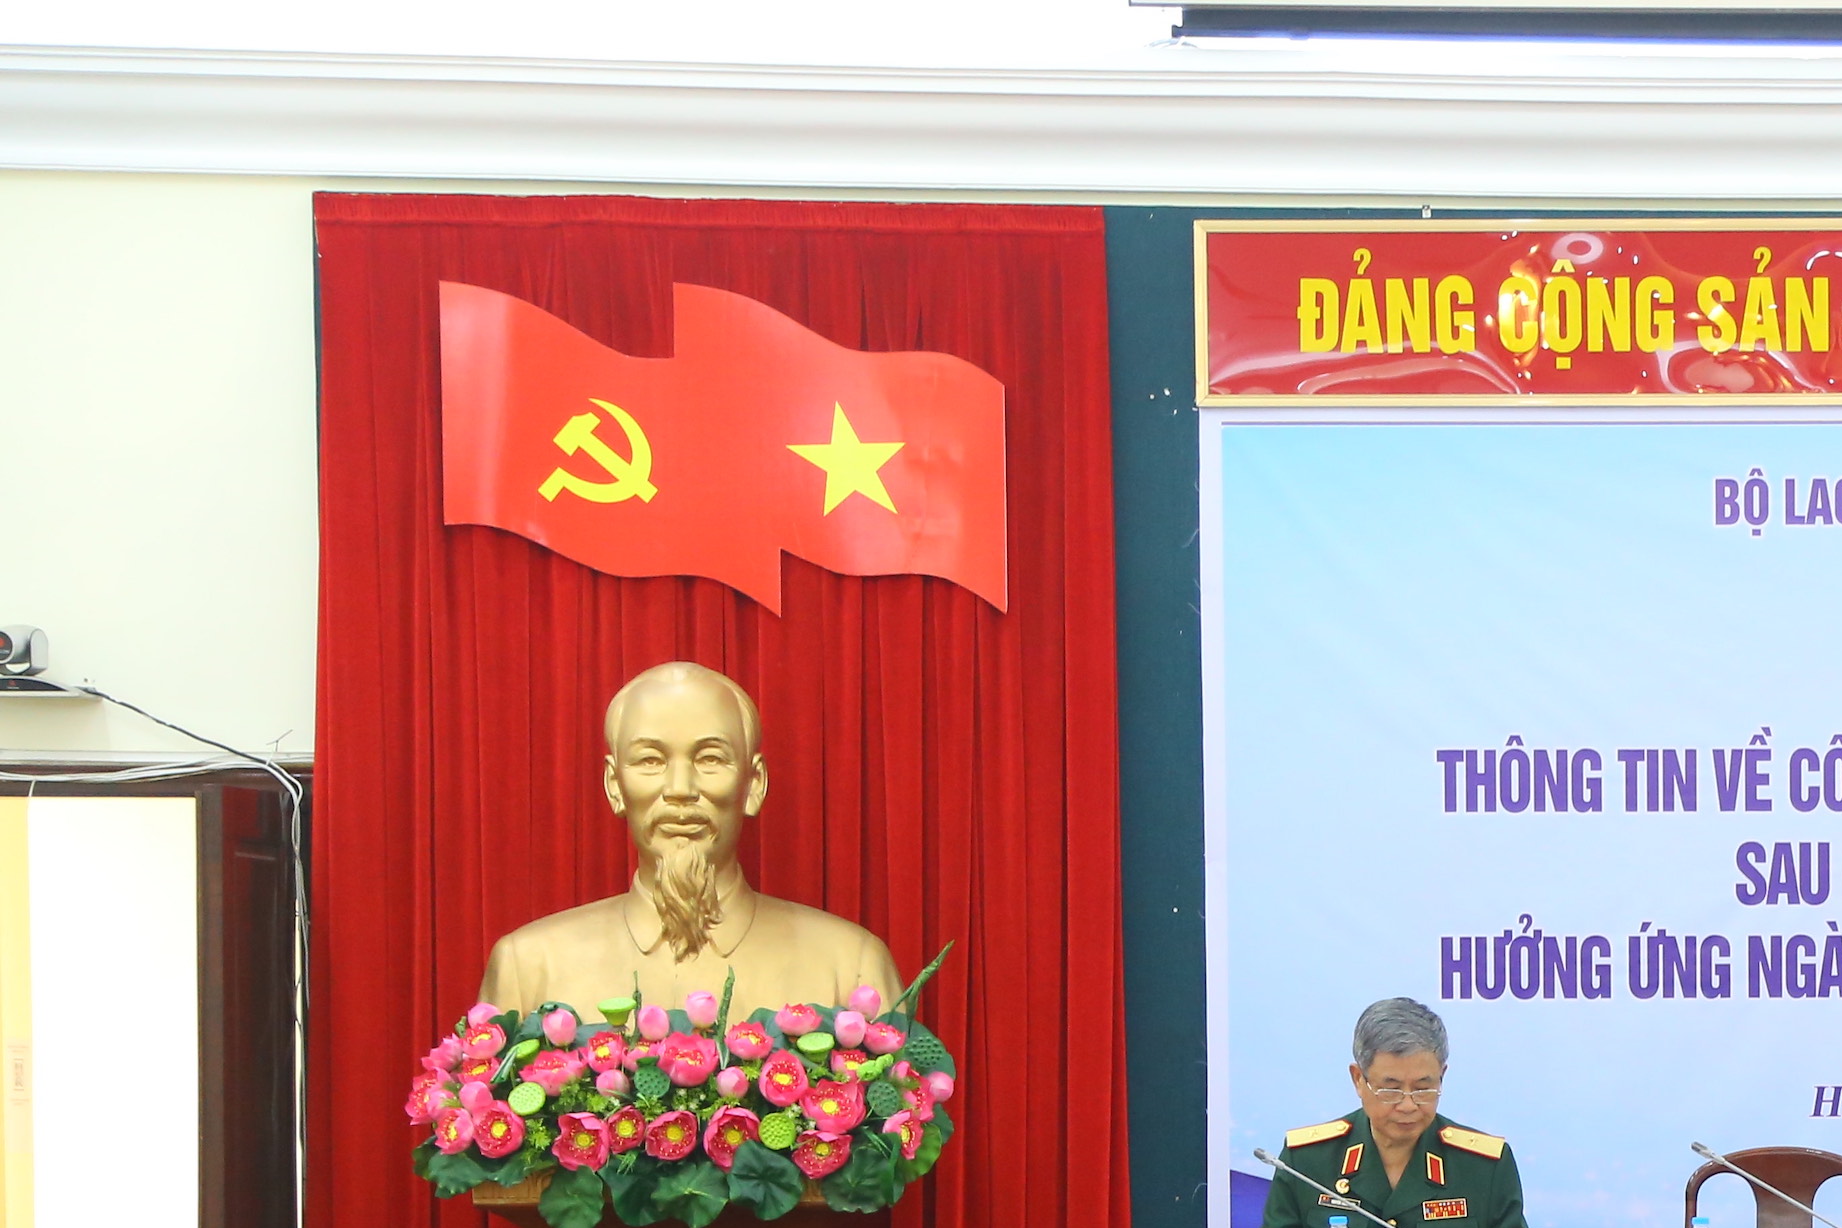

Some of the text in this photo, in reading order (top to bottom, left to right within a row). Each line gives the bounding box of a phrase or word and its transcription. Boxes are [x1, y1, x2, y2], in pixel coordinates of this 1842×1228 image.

[1298, 249, 1475, 354] ĐẢNG
[1498, 261, 1675, 369] CỘNG
[1697, 247, 1829, 353] SẢN
[1714, 468, 1769, 536] BỘ
[1436, 734, 1603, 814] THÔNG
[1617, 748, 1698, 812] TIN
[1712, 726, 1773, 812] VỀ
[1735, 841, 1831, 906] SAU
[1440, 913, 1612, 1000] HƯỞNG
[1628, 921, 1731, 1000] ỨNG
